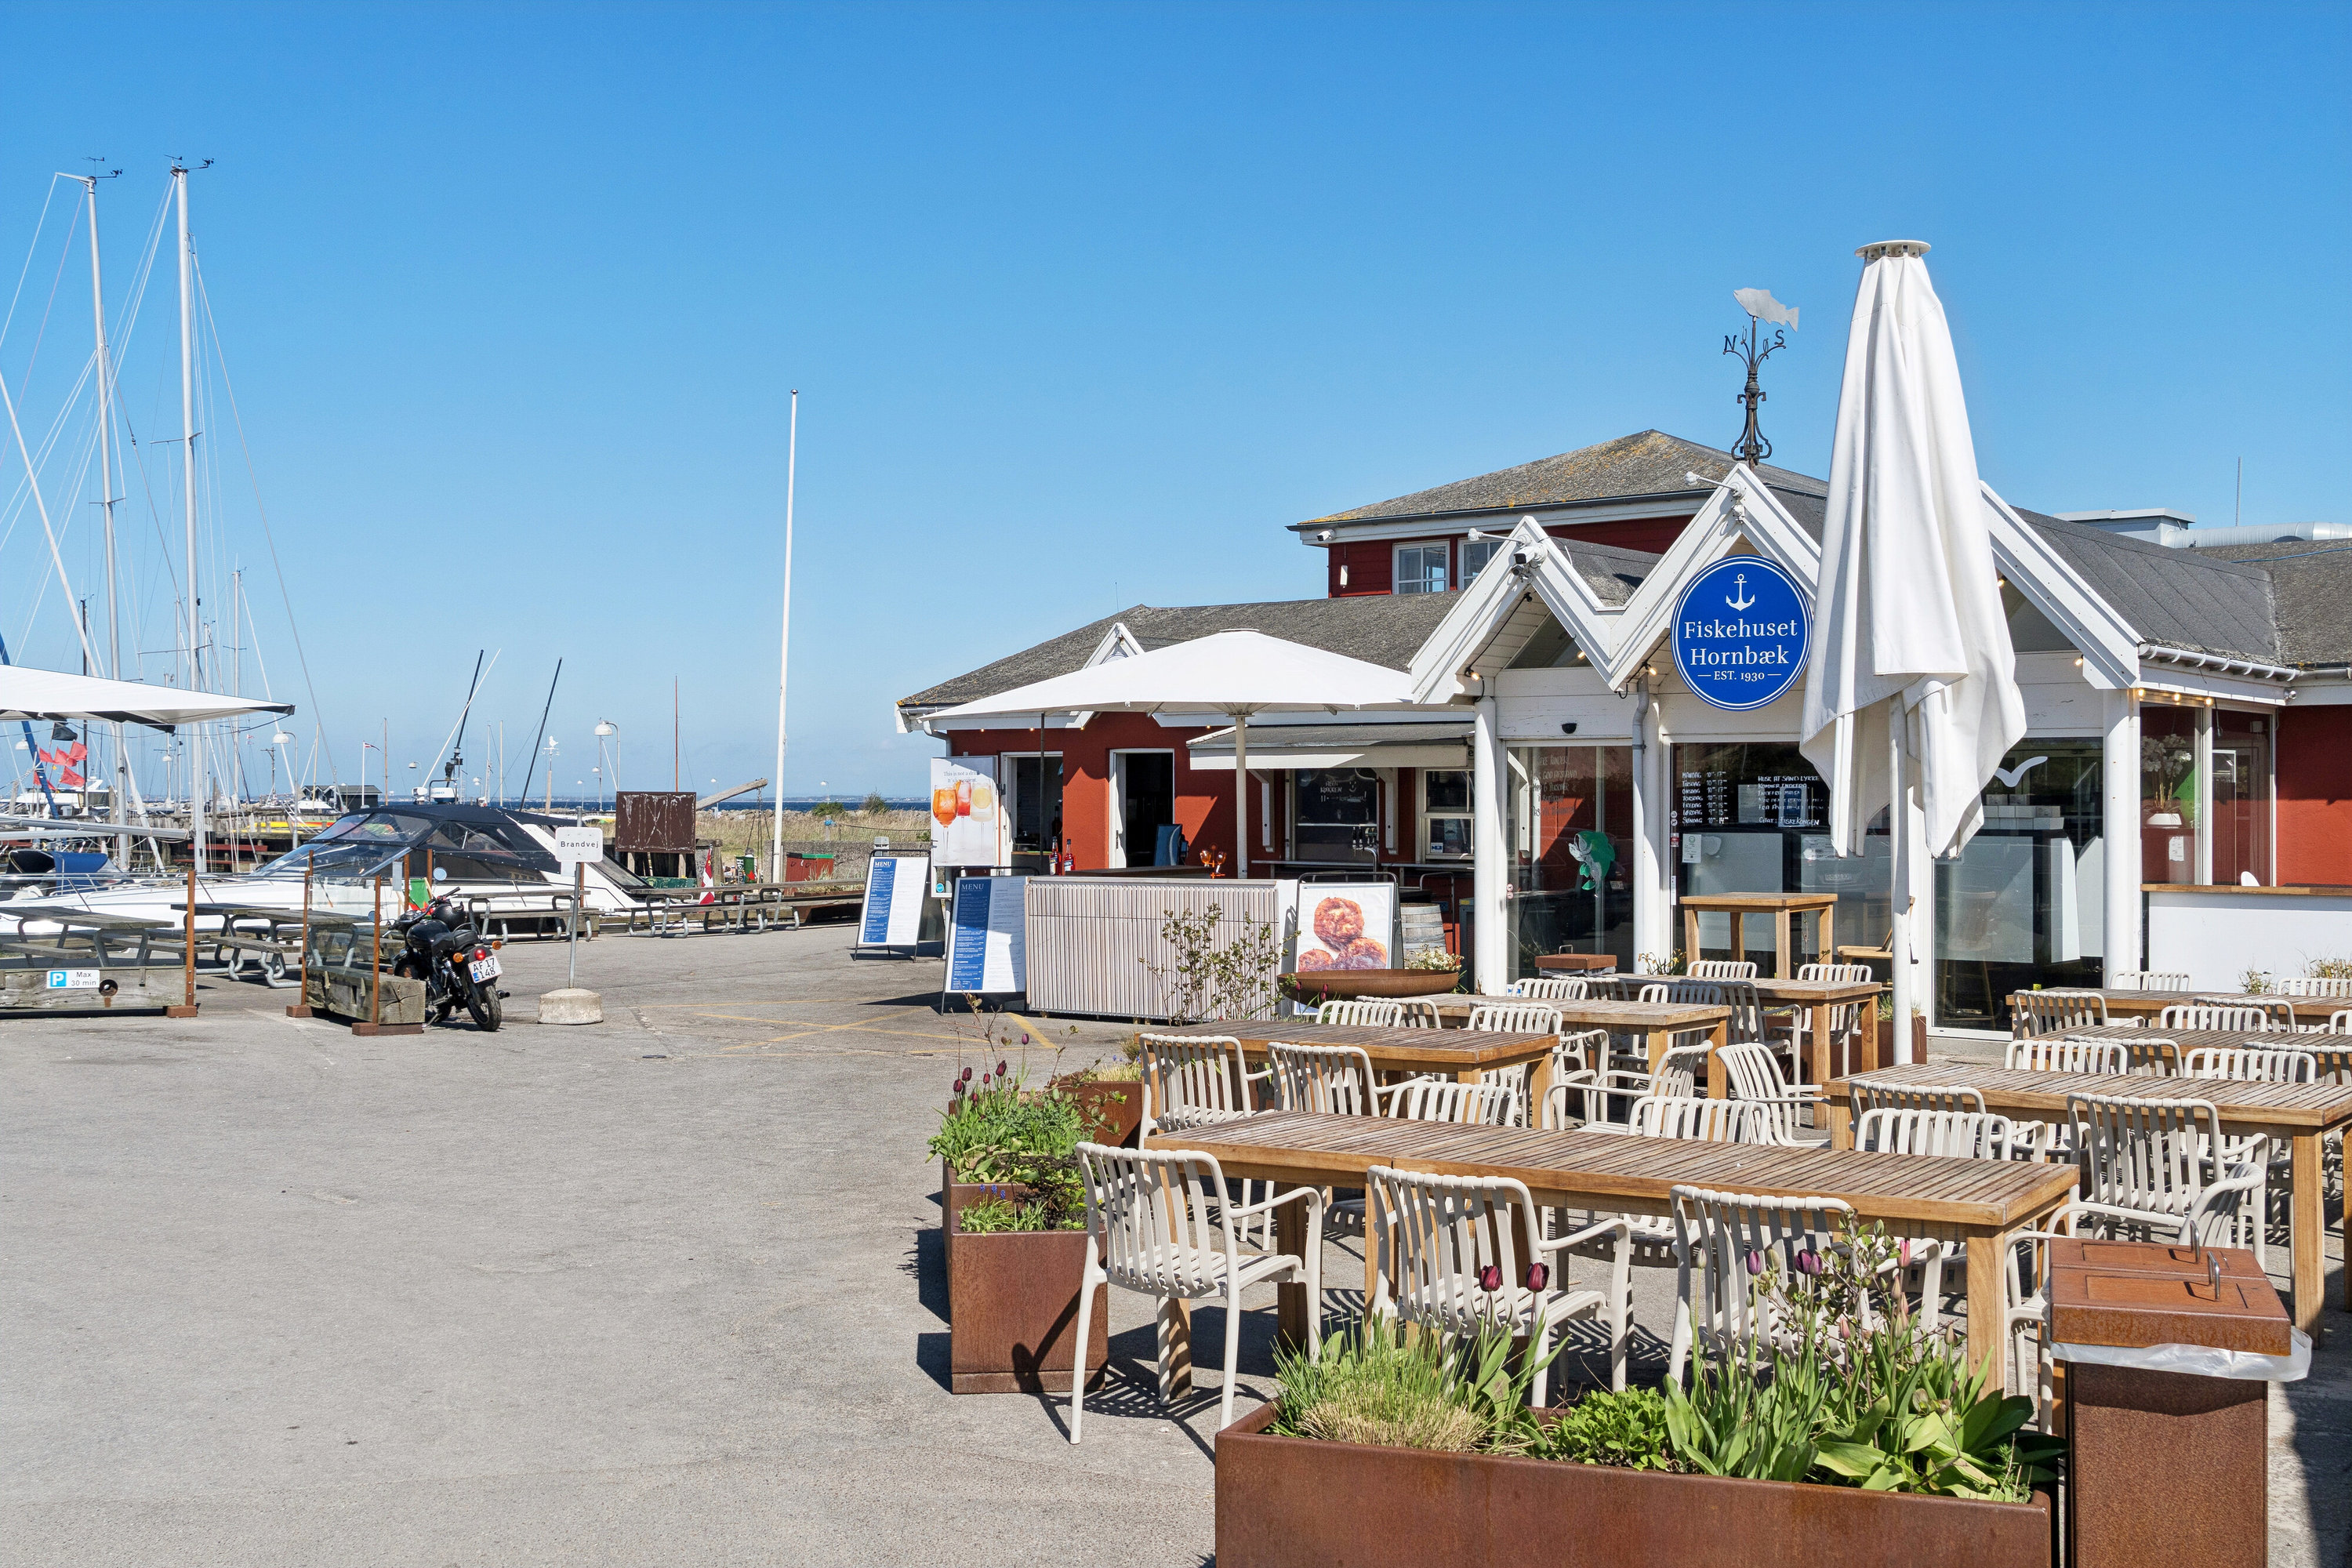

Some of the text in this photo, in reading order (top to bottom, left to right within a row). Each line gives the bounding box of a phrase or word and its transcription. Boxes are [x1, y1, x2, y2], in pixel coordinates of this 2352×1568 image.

[1724, 335, 1737, 351] N
[1774, 329, 1784, 346] S
[1684, 618, 1798, 639] Fiskehuset
[1690, 644, 1789, 666] Hornbæk
[1714, 670, 1765, 682] EST. 1930
[473, 957, 495, 972] AF 17
[479, 967, 495, 978] 148
